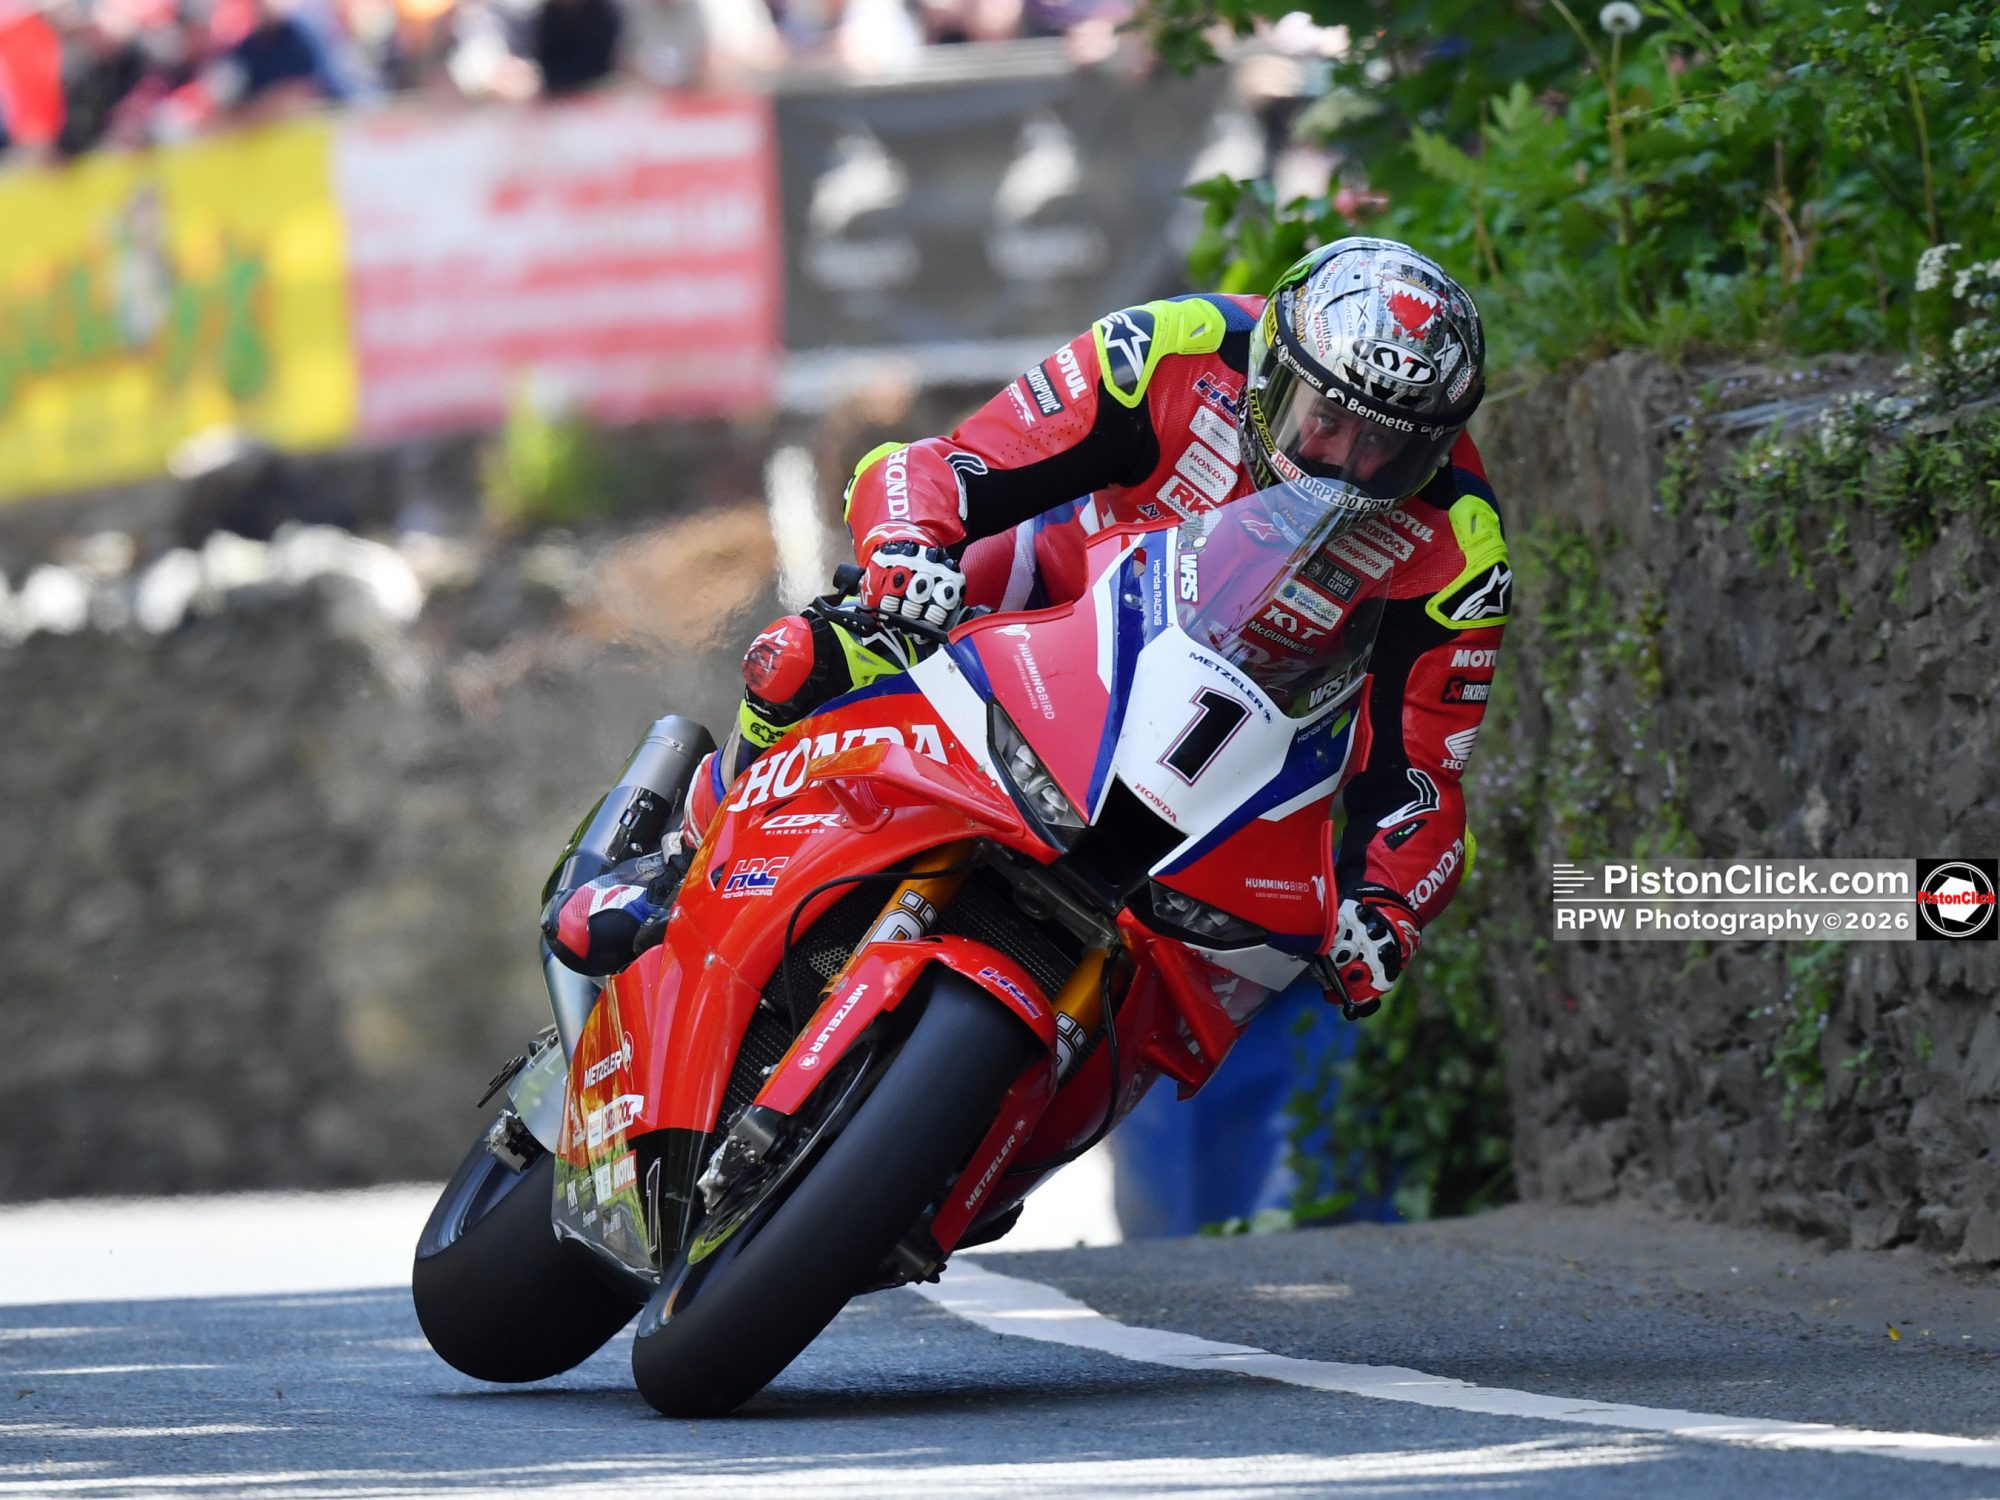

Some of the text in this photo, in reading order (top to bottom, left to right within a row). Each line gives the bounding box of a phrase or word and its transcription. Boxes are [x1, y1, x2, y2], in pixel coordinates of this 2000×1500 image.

[1287, 355, 1324, 389] TITANTECH
[1347, 397, 1415, 432] Bennetts
[885, 445, 911, 520] HOND
[1188, 450, 1228, 487] HONDA
[1169, 481, 1213, 516] RK
[1153, 559, 1162, 626] Honda RACING
[1180, 553, 1199, 603] WRS
[1248, 620, 1317, 656] McGUINNESS
[1017, 643, 1056, 721] HUMMINGBIRD
[1188, 651, 1266, 711] METZELER
[1309, 673, 1346, 710] WRS
[1157, 686, 1253, 788] 1
[1133, 783, 1178, 824] HONDA
[765, 828, 826, 836] FIREBLADE
[721, 888, 774, 900] Honda RACING
[1245, 877, 1310, 893] HUMMINGBIRD
[810, 983, 869, 1054] METZELER
[583, 1049, 624, 1091] METZELER
[613, 1154, 637, 1192] MOTUL
[965, 1134, 1017, 1210] METZELER
